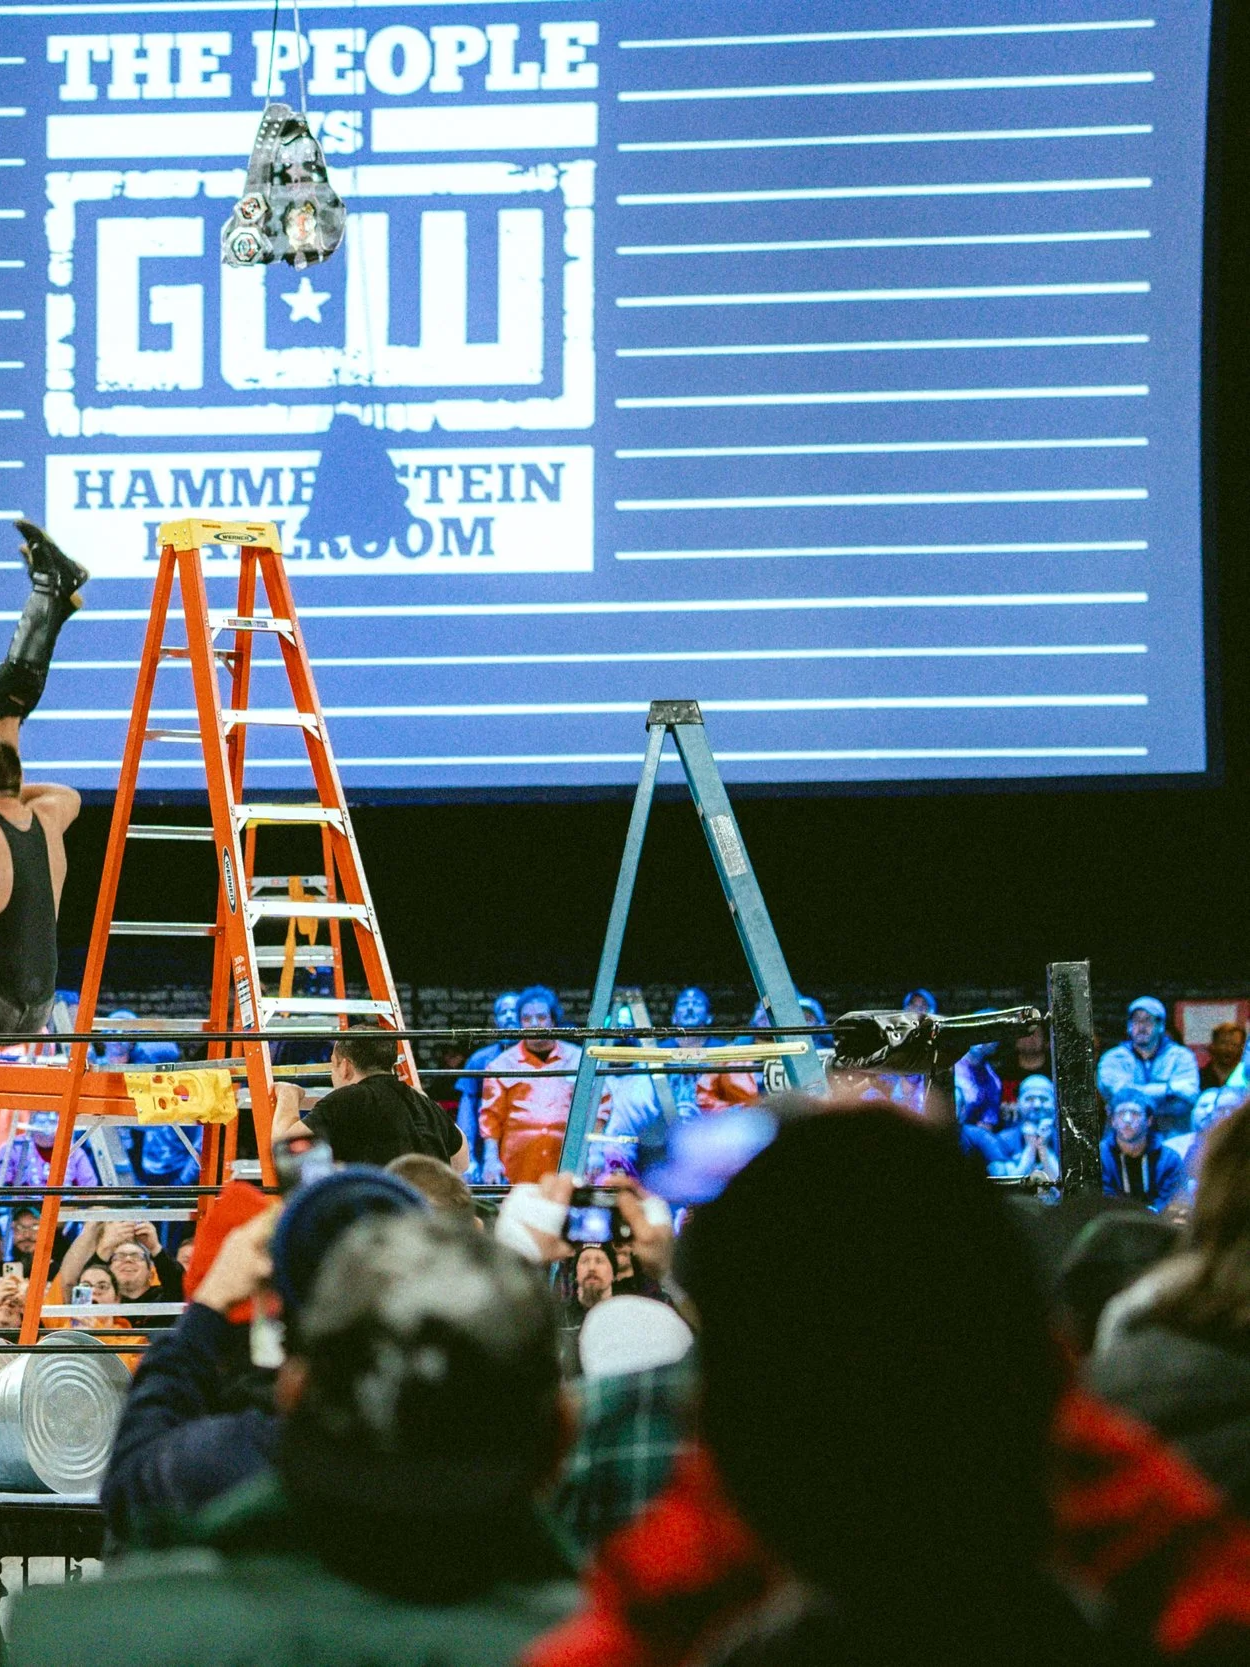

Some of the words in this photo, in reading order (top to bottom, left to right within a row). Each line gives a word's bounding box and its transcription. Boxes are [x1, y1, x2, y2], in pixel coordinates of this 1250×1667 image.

[47, 32, 232, 100] THE
[252, 21, 599, 96] PEOPLE
[96, 208, 545, 391] GCW
[73, 461, 566, 510] HAMMETEIN
[225, 860, 235, 901] WERNER
